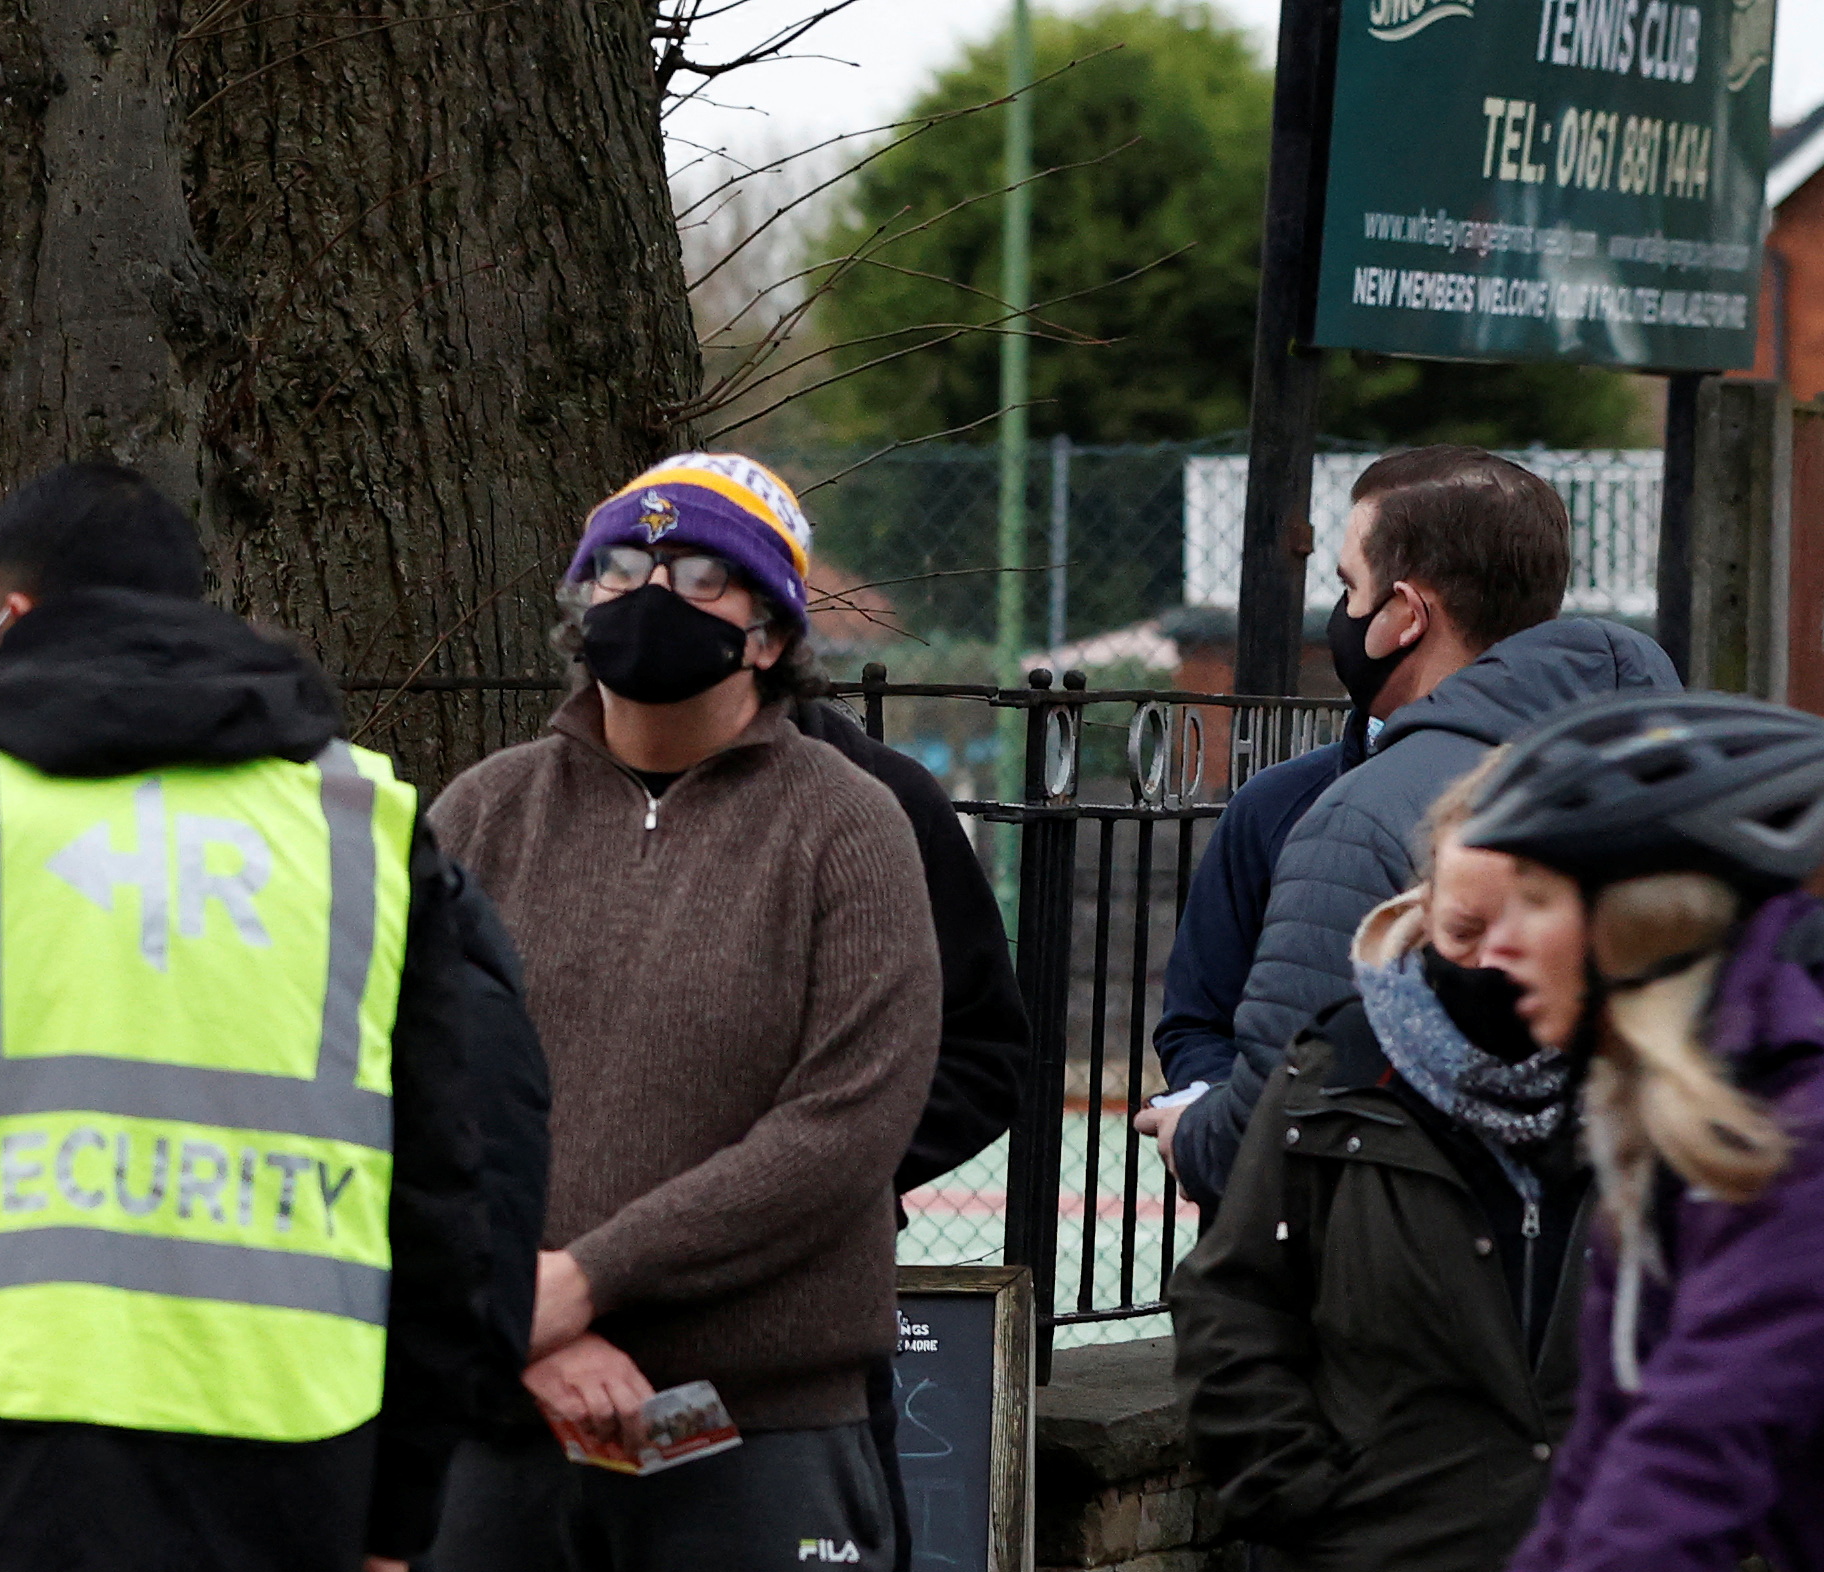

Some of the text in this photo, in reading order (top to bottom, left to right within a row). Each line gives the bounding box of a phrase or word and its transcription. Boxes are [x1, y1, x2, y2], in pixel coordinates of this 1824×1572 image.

[1640, 1, 1702, 84] CLUB
[1483, 97, 1552, 185] TEL:
[1556, 106, 1619, 191] 0161
[1618, 115, 1663, 196] 881
[1352, 266, 1397, 307] NEW
[1397, 270, 1476, 313] MEMBERS
[900, 1324, 930, 1336] NGS
[904, 1339, 939, 1352] MORE
[798, 1537, 861, 1564] FILA
